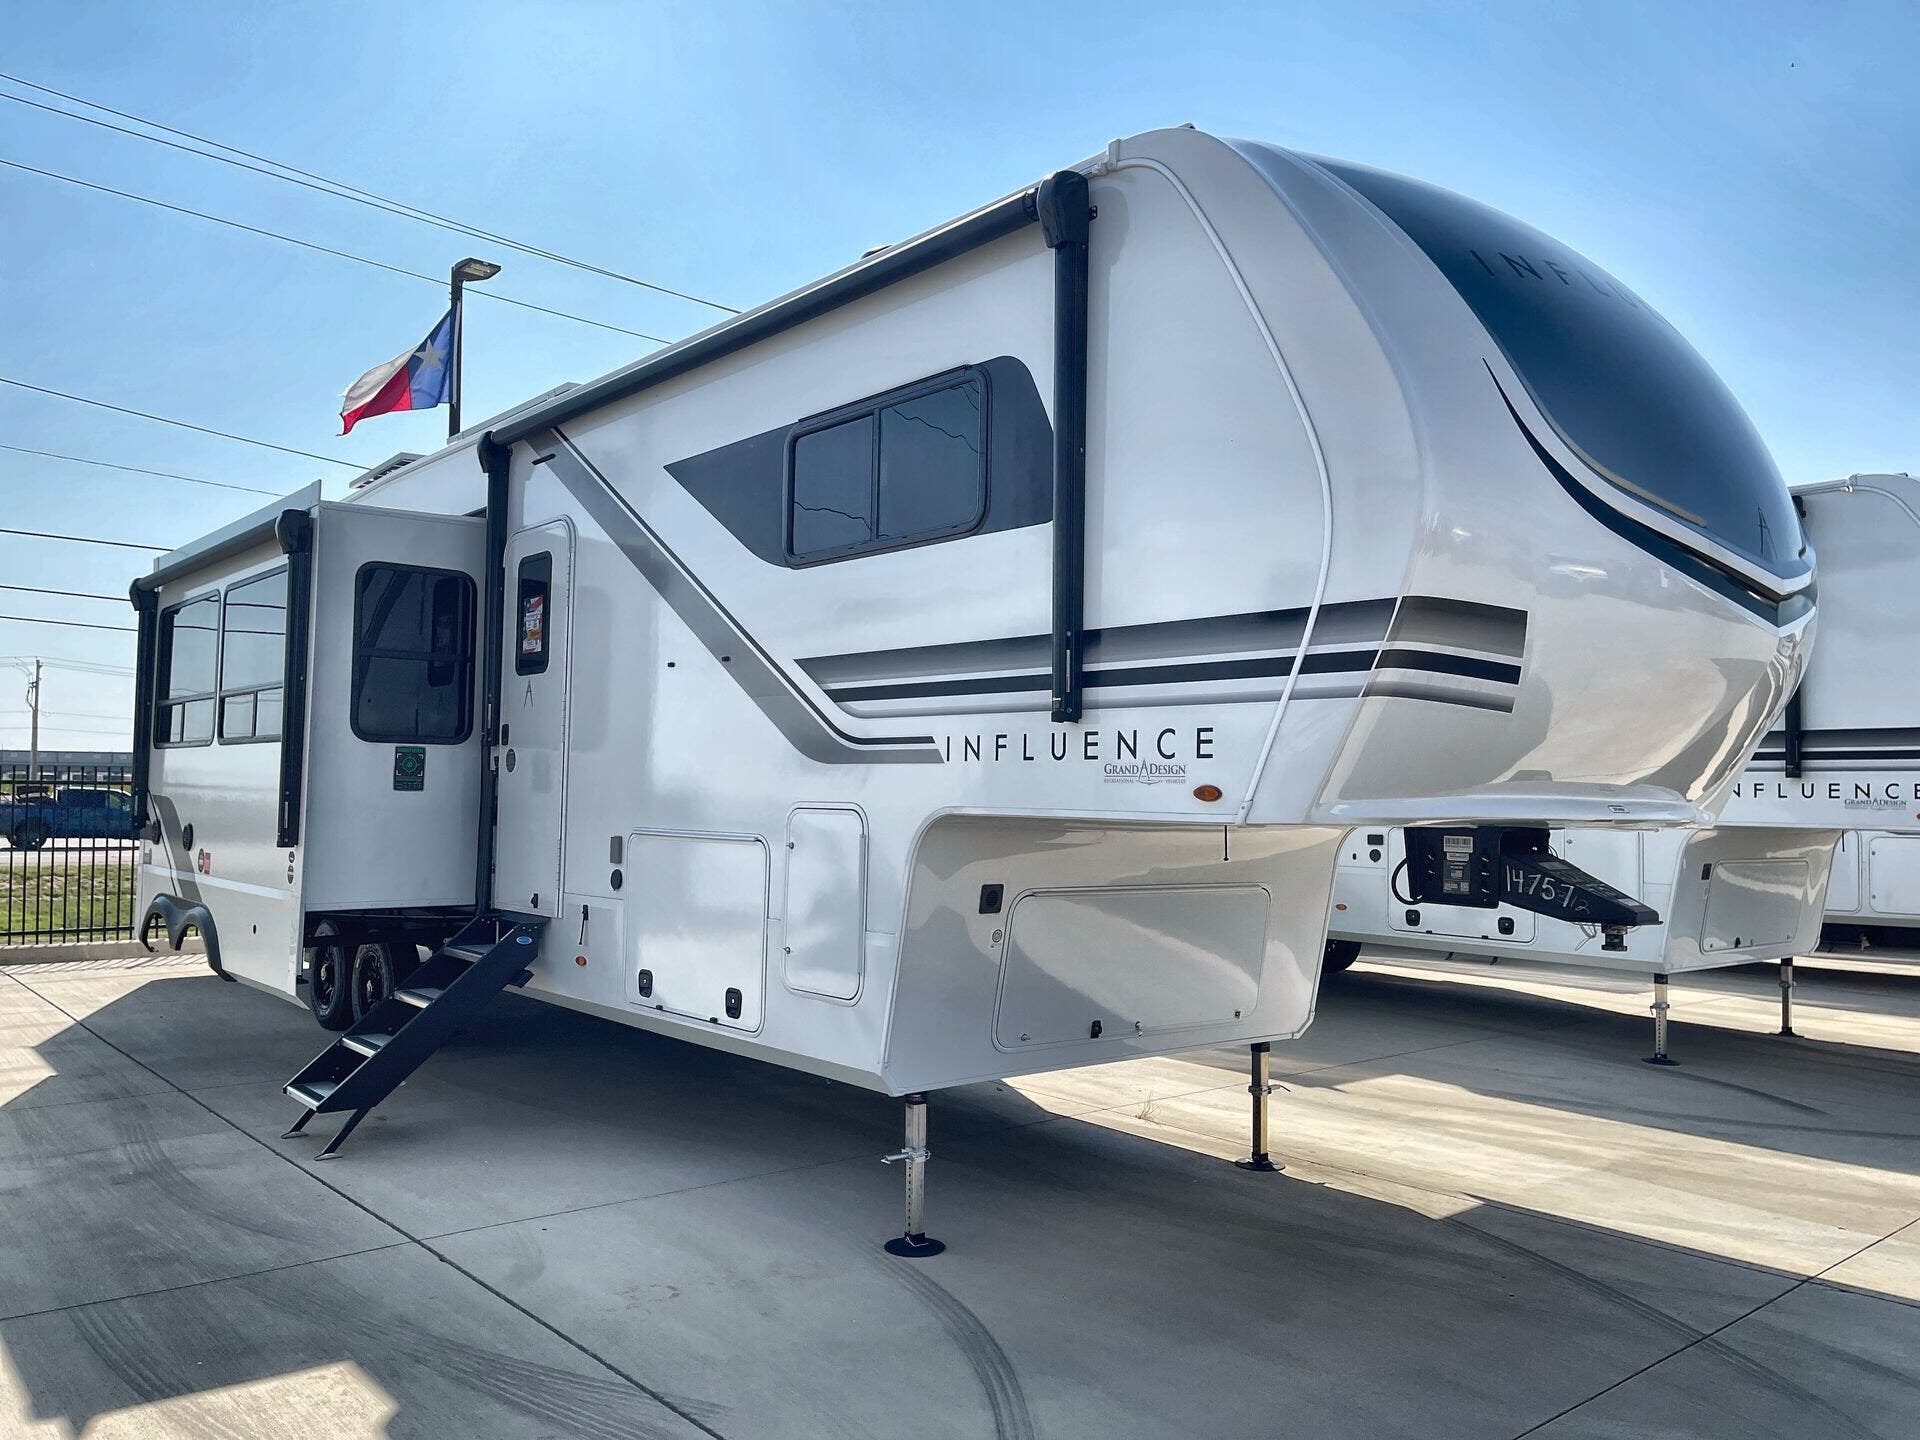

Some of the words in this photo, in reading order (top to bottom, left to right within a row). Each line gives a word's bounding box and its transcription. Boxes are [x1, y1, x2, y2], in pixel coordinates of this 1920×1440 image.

[945, 727, 1214, 761] INFLUENCE
[1103, 763, 1139, 775] GRAND
[1149, 763, 1186, 775] DESIGN
[1879, 798, 1907, 806] DESIGN
[1506, 865, 1575, 908] 14757
